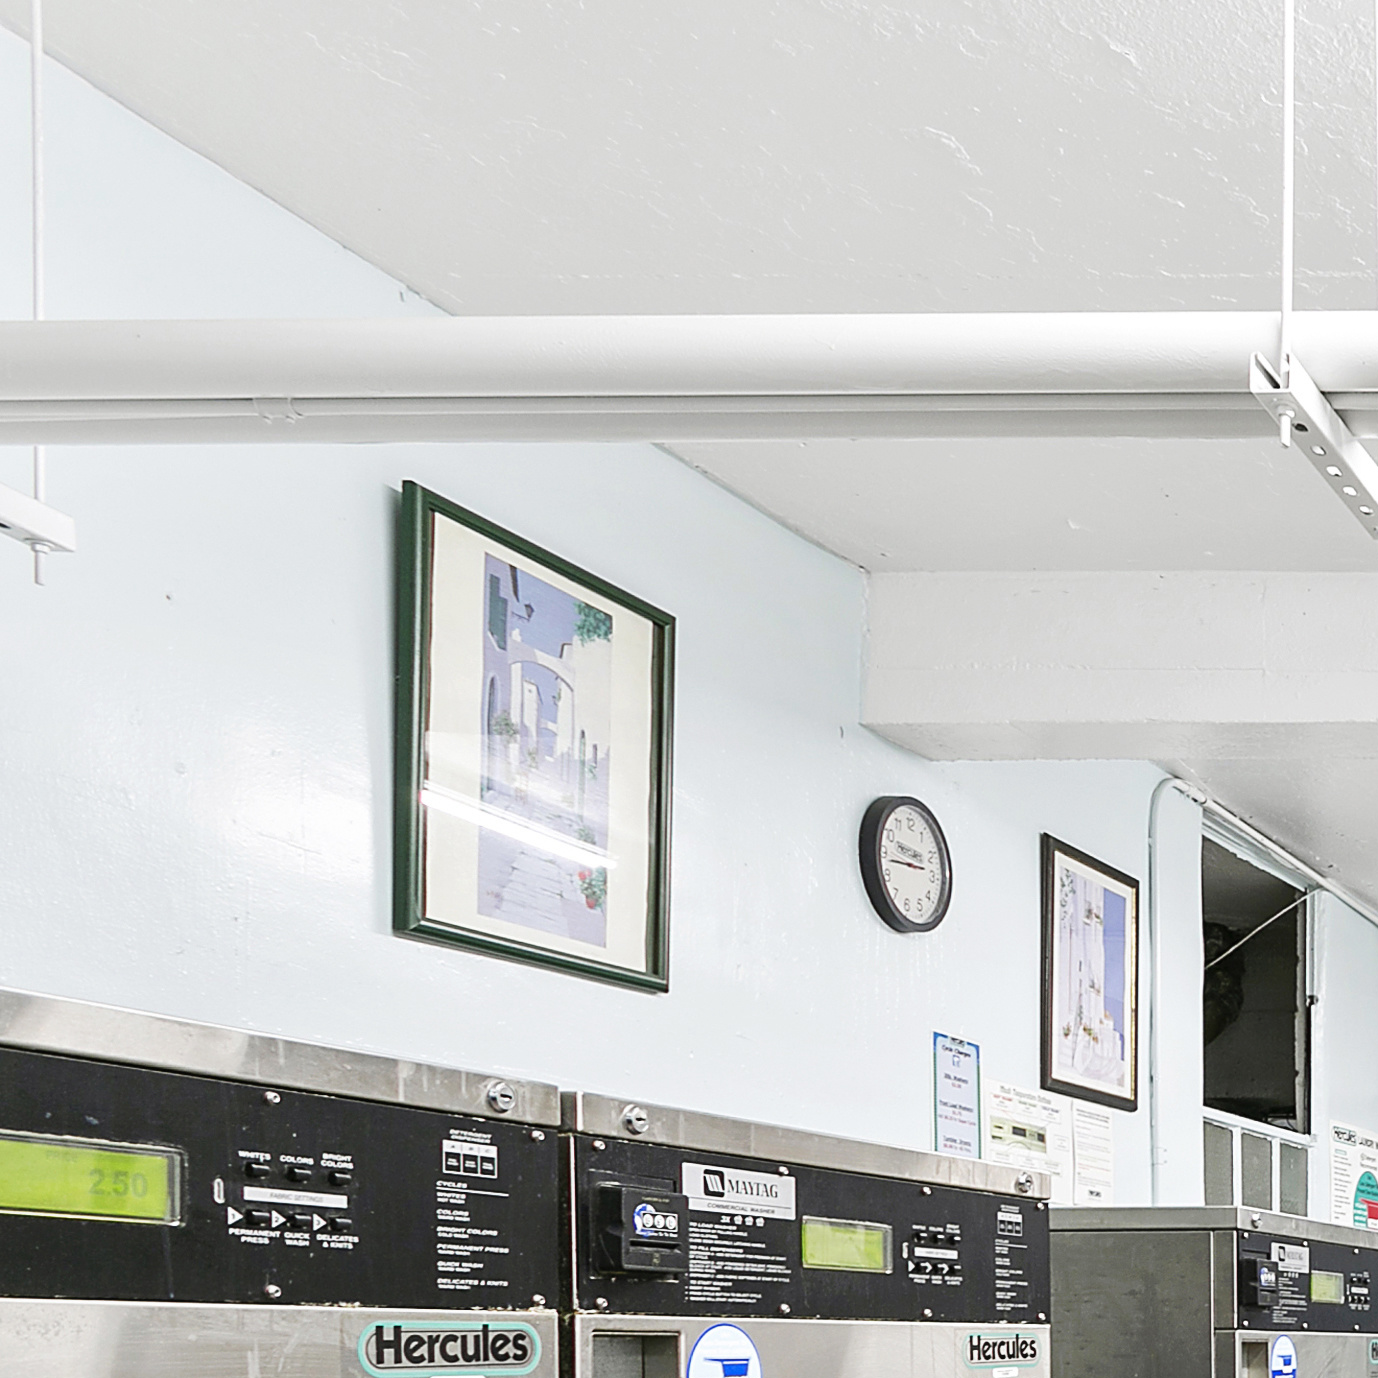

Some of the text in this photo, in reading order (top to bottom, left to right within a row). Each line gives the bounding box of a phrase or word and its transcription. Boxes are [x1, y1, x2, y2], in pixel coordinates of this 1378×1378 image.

[238, 1150, 272, 1161] WHITES
[279, 1154, 315, 1166] COLORS
[322, 1152, 353, 1162] BRIGHT
[320, 1159, 354, 1170] COLORS
[88, 1168, 149, 1199] 2.50
[727, 1179, 779, 1199] MAYTAG
[269, 1191, 294, 1202] FABRIC
[707, 1202, 749, 1213] COMMERCIAL
[228, 1227, 281, 1239] PERMANENT
[284, 1231, 311, 1240] QUICK
[316, 1233, 360, 1244] DELICATES
[240, 1235, 270, 1245] PRESS
[285, 1239, 310, 1247] WASH
[329, 1241, 354, 1250] KNITS
[375, 1324, 529, 1365] Hercules
[969, 1334, 1037, 1361] Hercules
